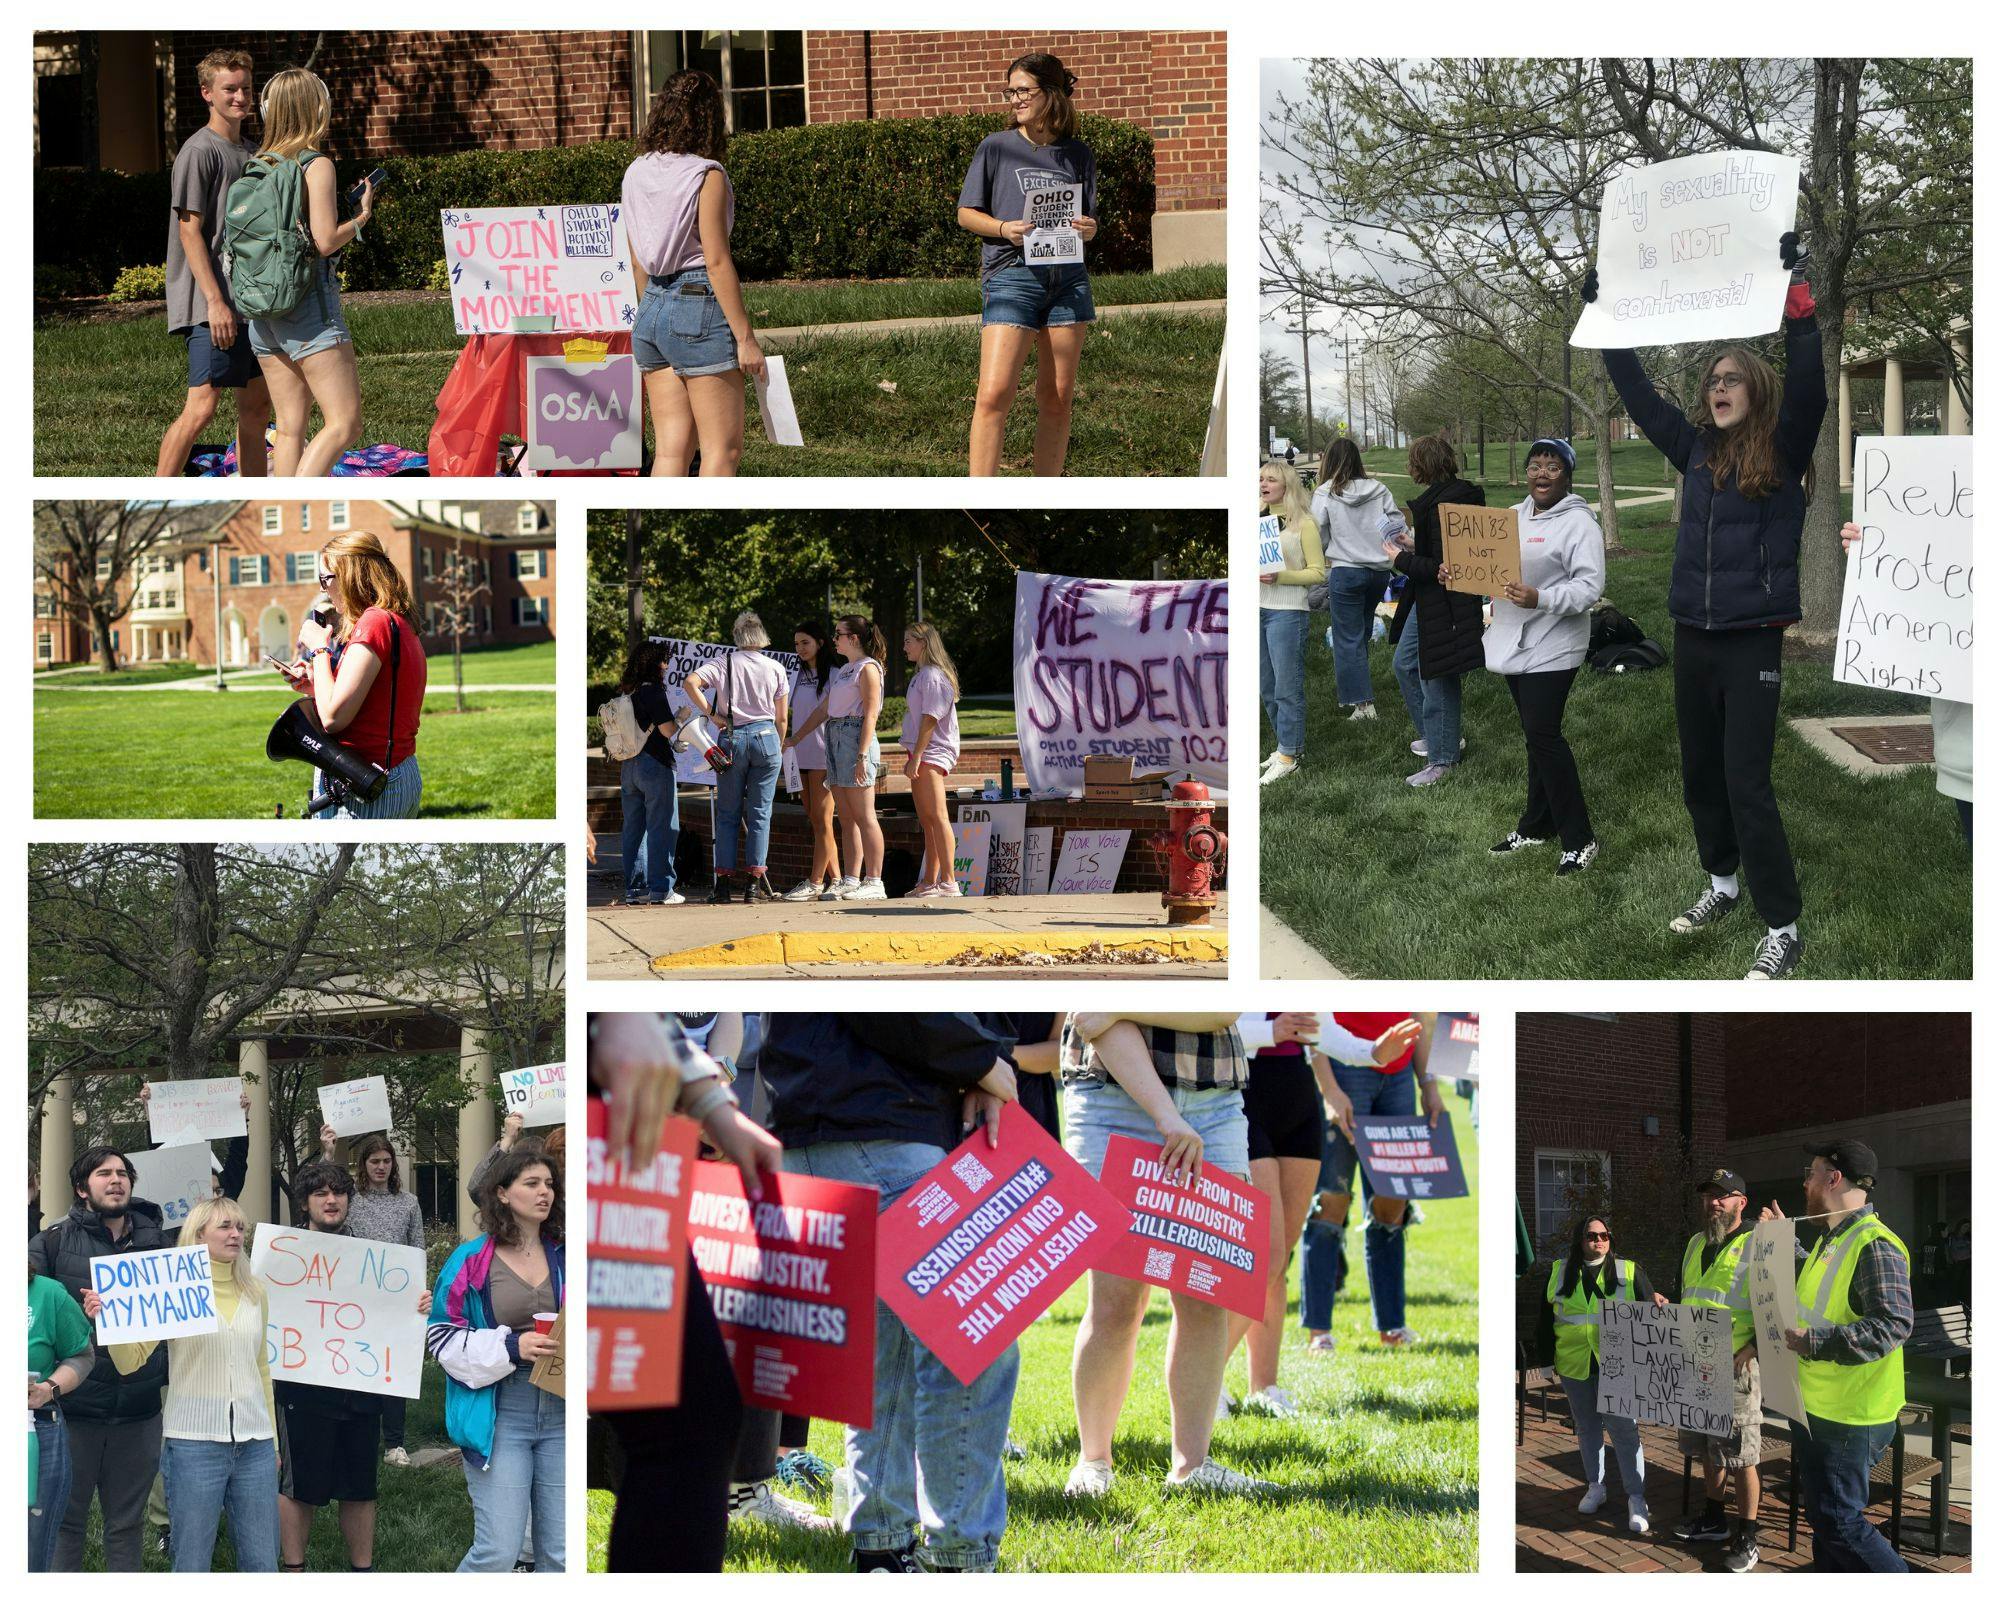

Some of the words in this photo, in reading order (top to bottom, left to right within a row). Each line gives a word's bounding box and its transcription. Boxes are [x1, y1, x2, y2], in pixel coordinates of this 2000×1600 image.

[1023, 177, 1068, 190] EXCELSIO
[1033, 190, 1075, 205] OHIO
[1611, 177, 1648, 232] My
[1660, 156, 1775, 212] sexuality
[568, 206, 599, 220] OHIO
[1030, 217, 1076, 229] SURVEY
[1031, 203, 1075, 214] STUDENT
[1031, 210, 1075, 220] LISTENING
[456, 219, 559, 260] JOIN
[566, 217, 608, 233] STUDENT
[568, 231, 611, 246] ACTIVIST
[565, 244, 609, 256] ALLIANCE
[1638, 243, 1657, 269] is
[1671, 223, 1730, 264] NOT
[499, 265, 559, 293] THE
[460, 290, 622, 331] MOVEMENT
[1613, 273, 1753, 321] controversial
[541, 389, 623, 421] OSAA
[1259, 518, 1280, 539] AKE
[1447, 511, 1484, 540] BAN
[1260, 541, 1283, 565] JOR
[1858, 525, 1974, 599] Prote
[1036, 583, 1110, 650] WE
[1131, 583, 1228, 634] THE
[1843, 639, 1942, 694] Rights
[302, 735, 322, 750] PYLE
[1089, 737, 1174, 754] STUDENT
[1044, 755, 1085, 770] ACTIVIS
[1073, 852, 1101, 874] IS
[512, 1071, 534, 1088] NO
[506, 1089, 527, 1105] TO
[1364, 1126, 1391, 1140] GUNS
[1390, 1126, 1411, 1139] ARE
[1410, 1125, 1431, 1139] THE
[164, 1198, 190, 1220] 83
[1195, 1176, 1230, 1208] FROM
[1232, 1193, 1254, 1220] THE
[688, 1190, 749, 1234] DIVEST
[755, 1202, 803, 1242] FROM
[805, 1209, 846, 1249] THE
[906, 1161, 1048, 1294] #KILLERBUSINESS
[1021, 1195, 1064, 1236] GUN
[1135, 1186, 1175, 1213] GUN
[1177, 1197, 1246, 1242] INDUSTRY.
[1037, 1210, 1098, 1271] DIVEST
[1128, 1212, 1254, 1271] KILLERBUSINESS
[95, 1256, 159, 1294] DONT
[162, 1250, 211, 1283] TAKE
[265, 1236, 341, 1291] SAY
[692, 1236, 728, 1275] GUN
[731, 1245, 831, 1295] INDUSTRY.
[942, 1223, 1034, 1308] INDUSTRY.
[1189, 1267, 1222, 1283] STUDENTS
[992, 1257, 1048, 1312] FROM
[1187, 1278, 1211, 1291] ACTION
[1188, 1273, 1215, 1287] DEMAND
[100, 1296, 133, 1328] MY
[139, 1285, 214, 1327] MAJOR
[305, 1299, 365, 1331] TO
[706, 1283, 847, 1344] LERBUSINESS
[1603, 1300, 1644, 1325] HOW
[1650, 1304, 1678, 1322] CAN
[1691, 1307, 1719, 1324] WE
[958, 1301, 1004, 1344] THE
[1631, 1320, 1683, 1347] LIVE
[325, 1338, 392, 1383] 83!
[1632, 1344, 1696, 1376] LAUGH
[1634, 1375, 1685, 1404] LOVE
[1650, 1365, 1680, 1387] AND
[1604, 1395, 1631, 1415] IN
[1635, 1397, 1676, 1426] THIS
[1675, 1402, 1733, 1438] ECONOMY
